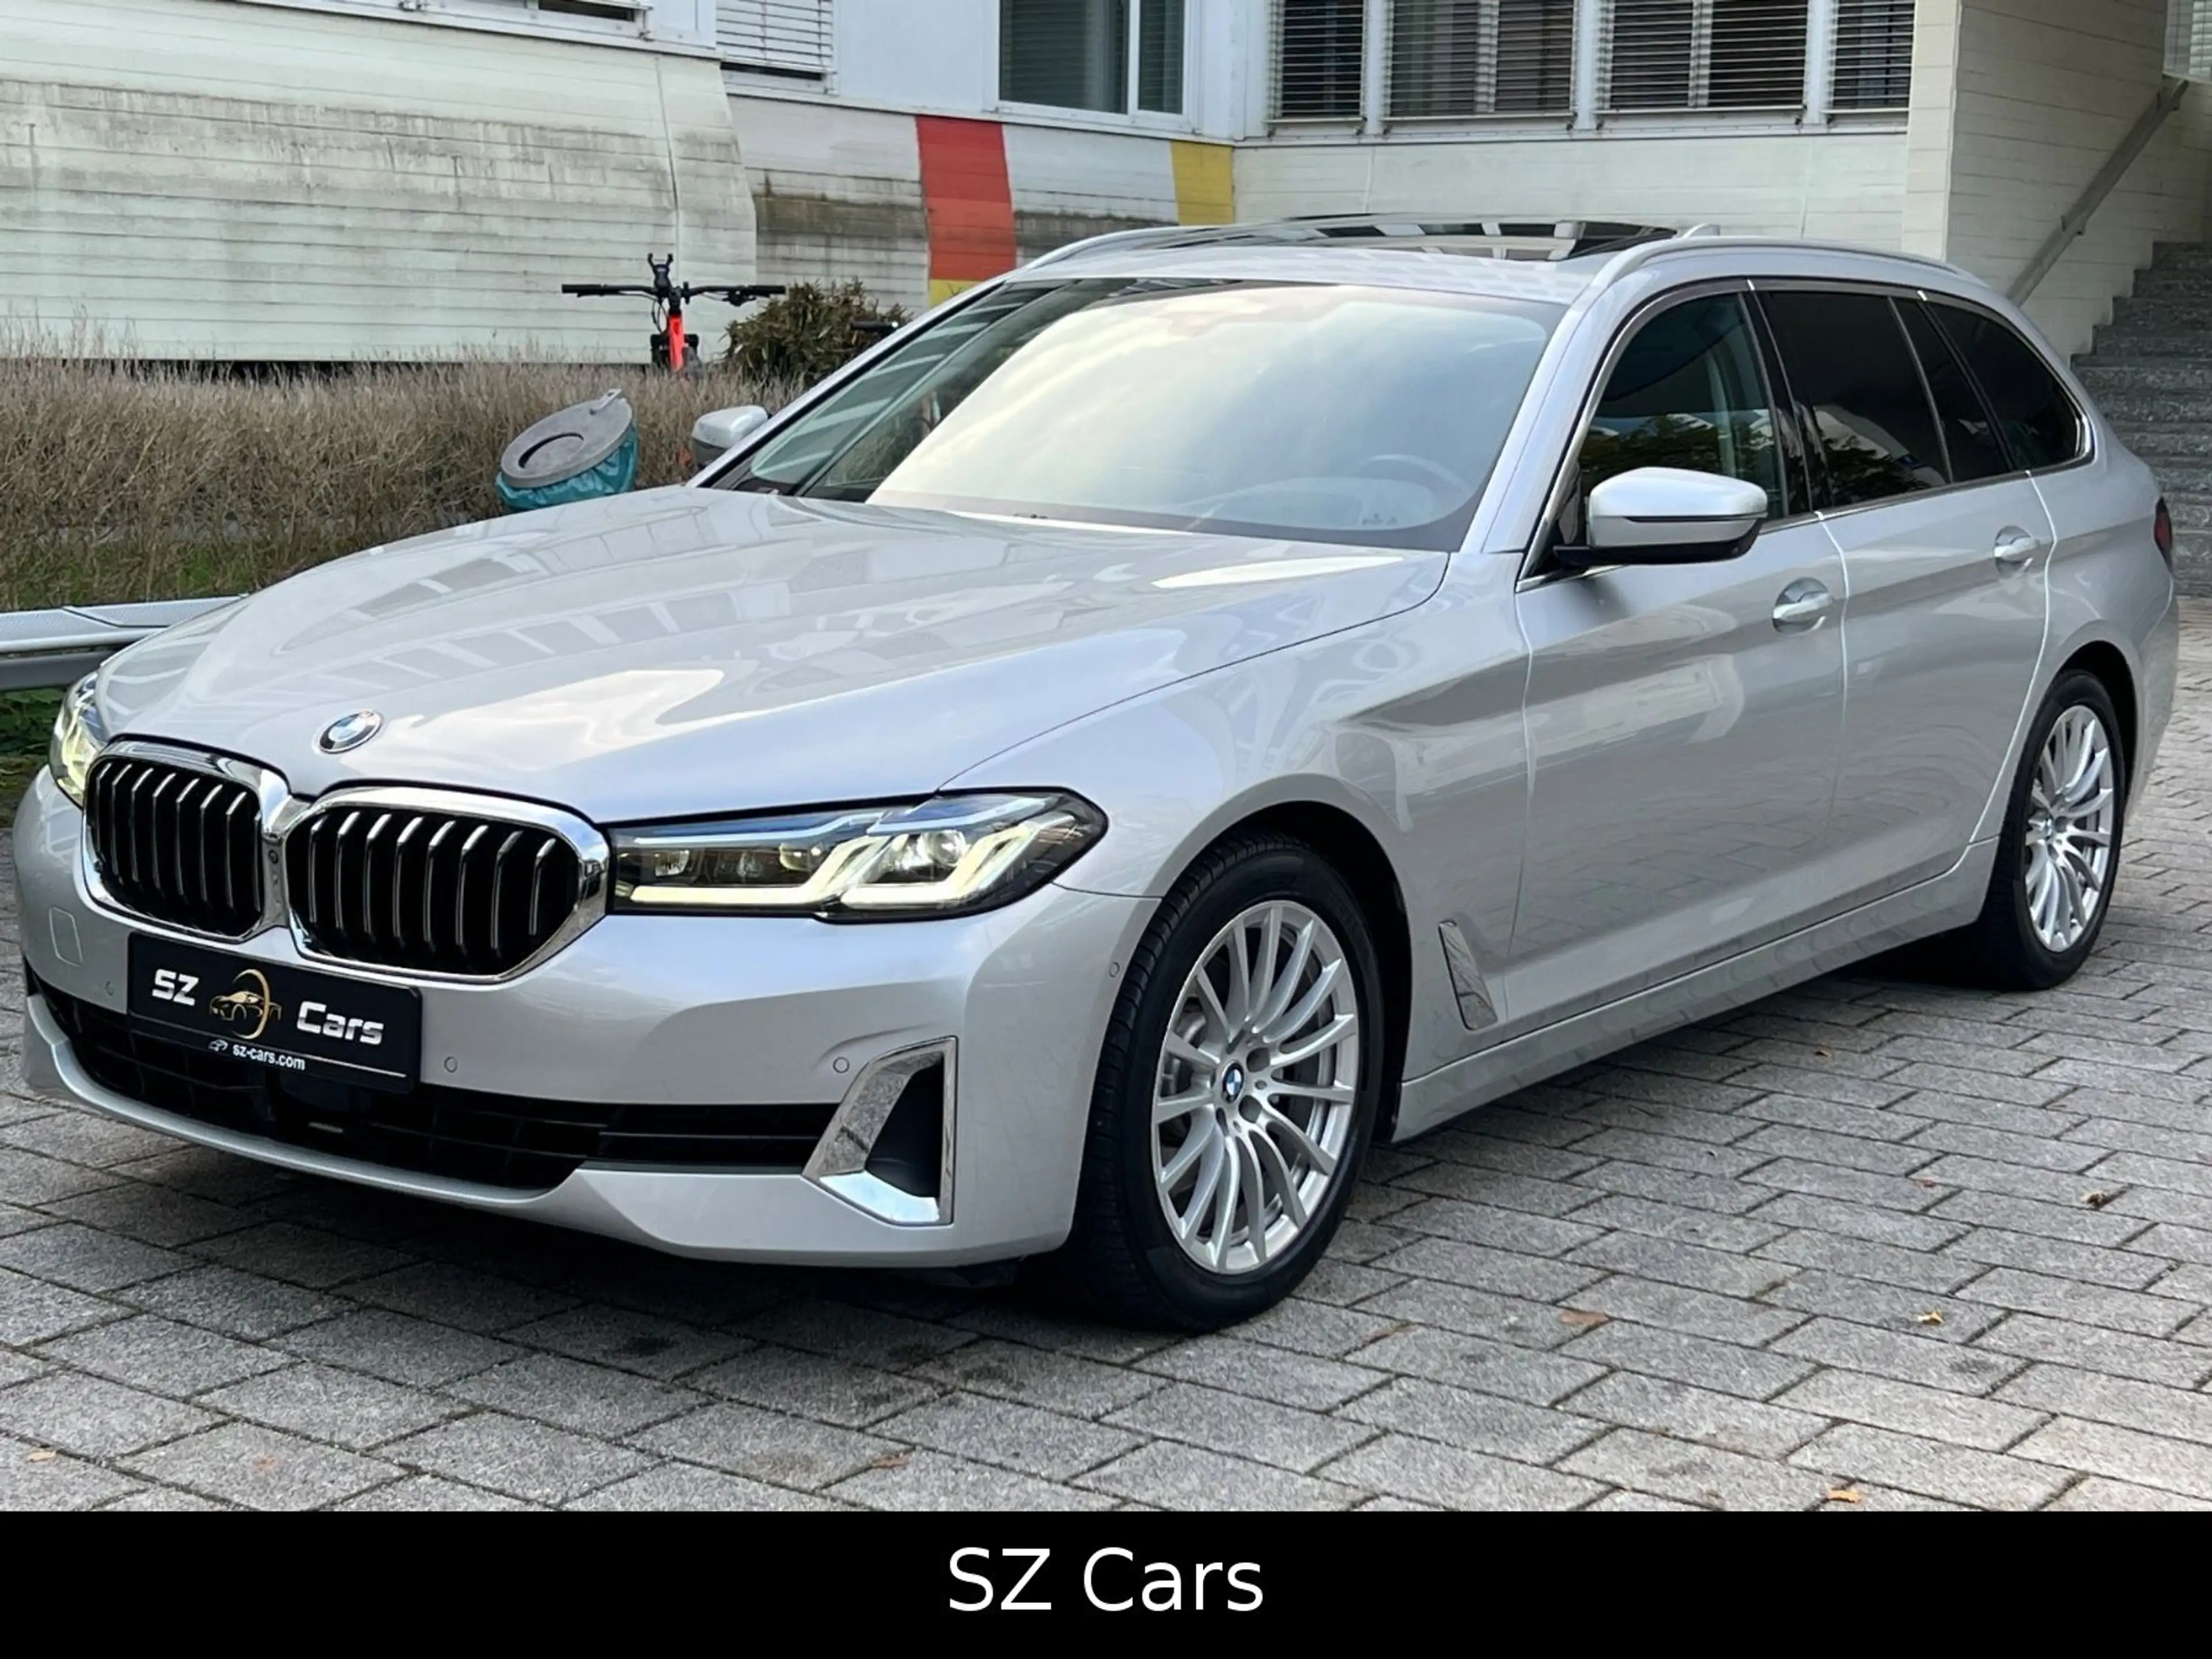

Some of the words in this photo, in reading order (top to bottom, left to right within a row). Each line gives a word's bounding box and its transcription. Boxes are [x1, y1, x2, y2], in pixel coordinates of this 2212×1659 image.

[152, 968, 199, 1006] SZ
[297, 1001, 384, 1045] Cars
[233, 1044, 305, 1070] sz-cars.com
